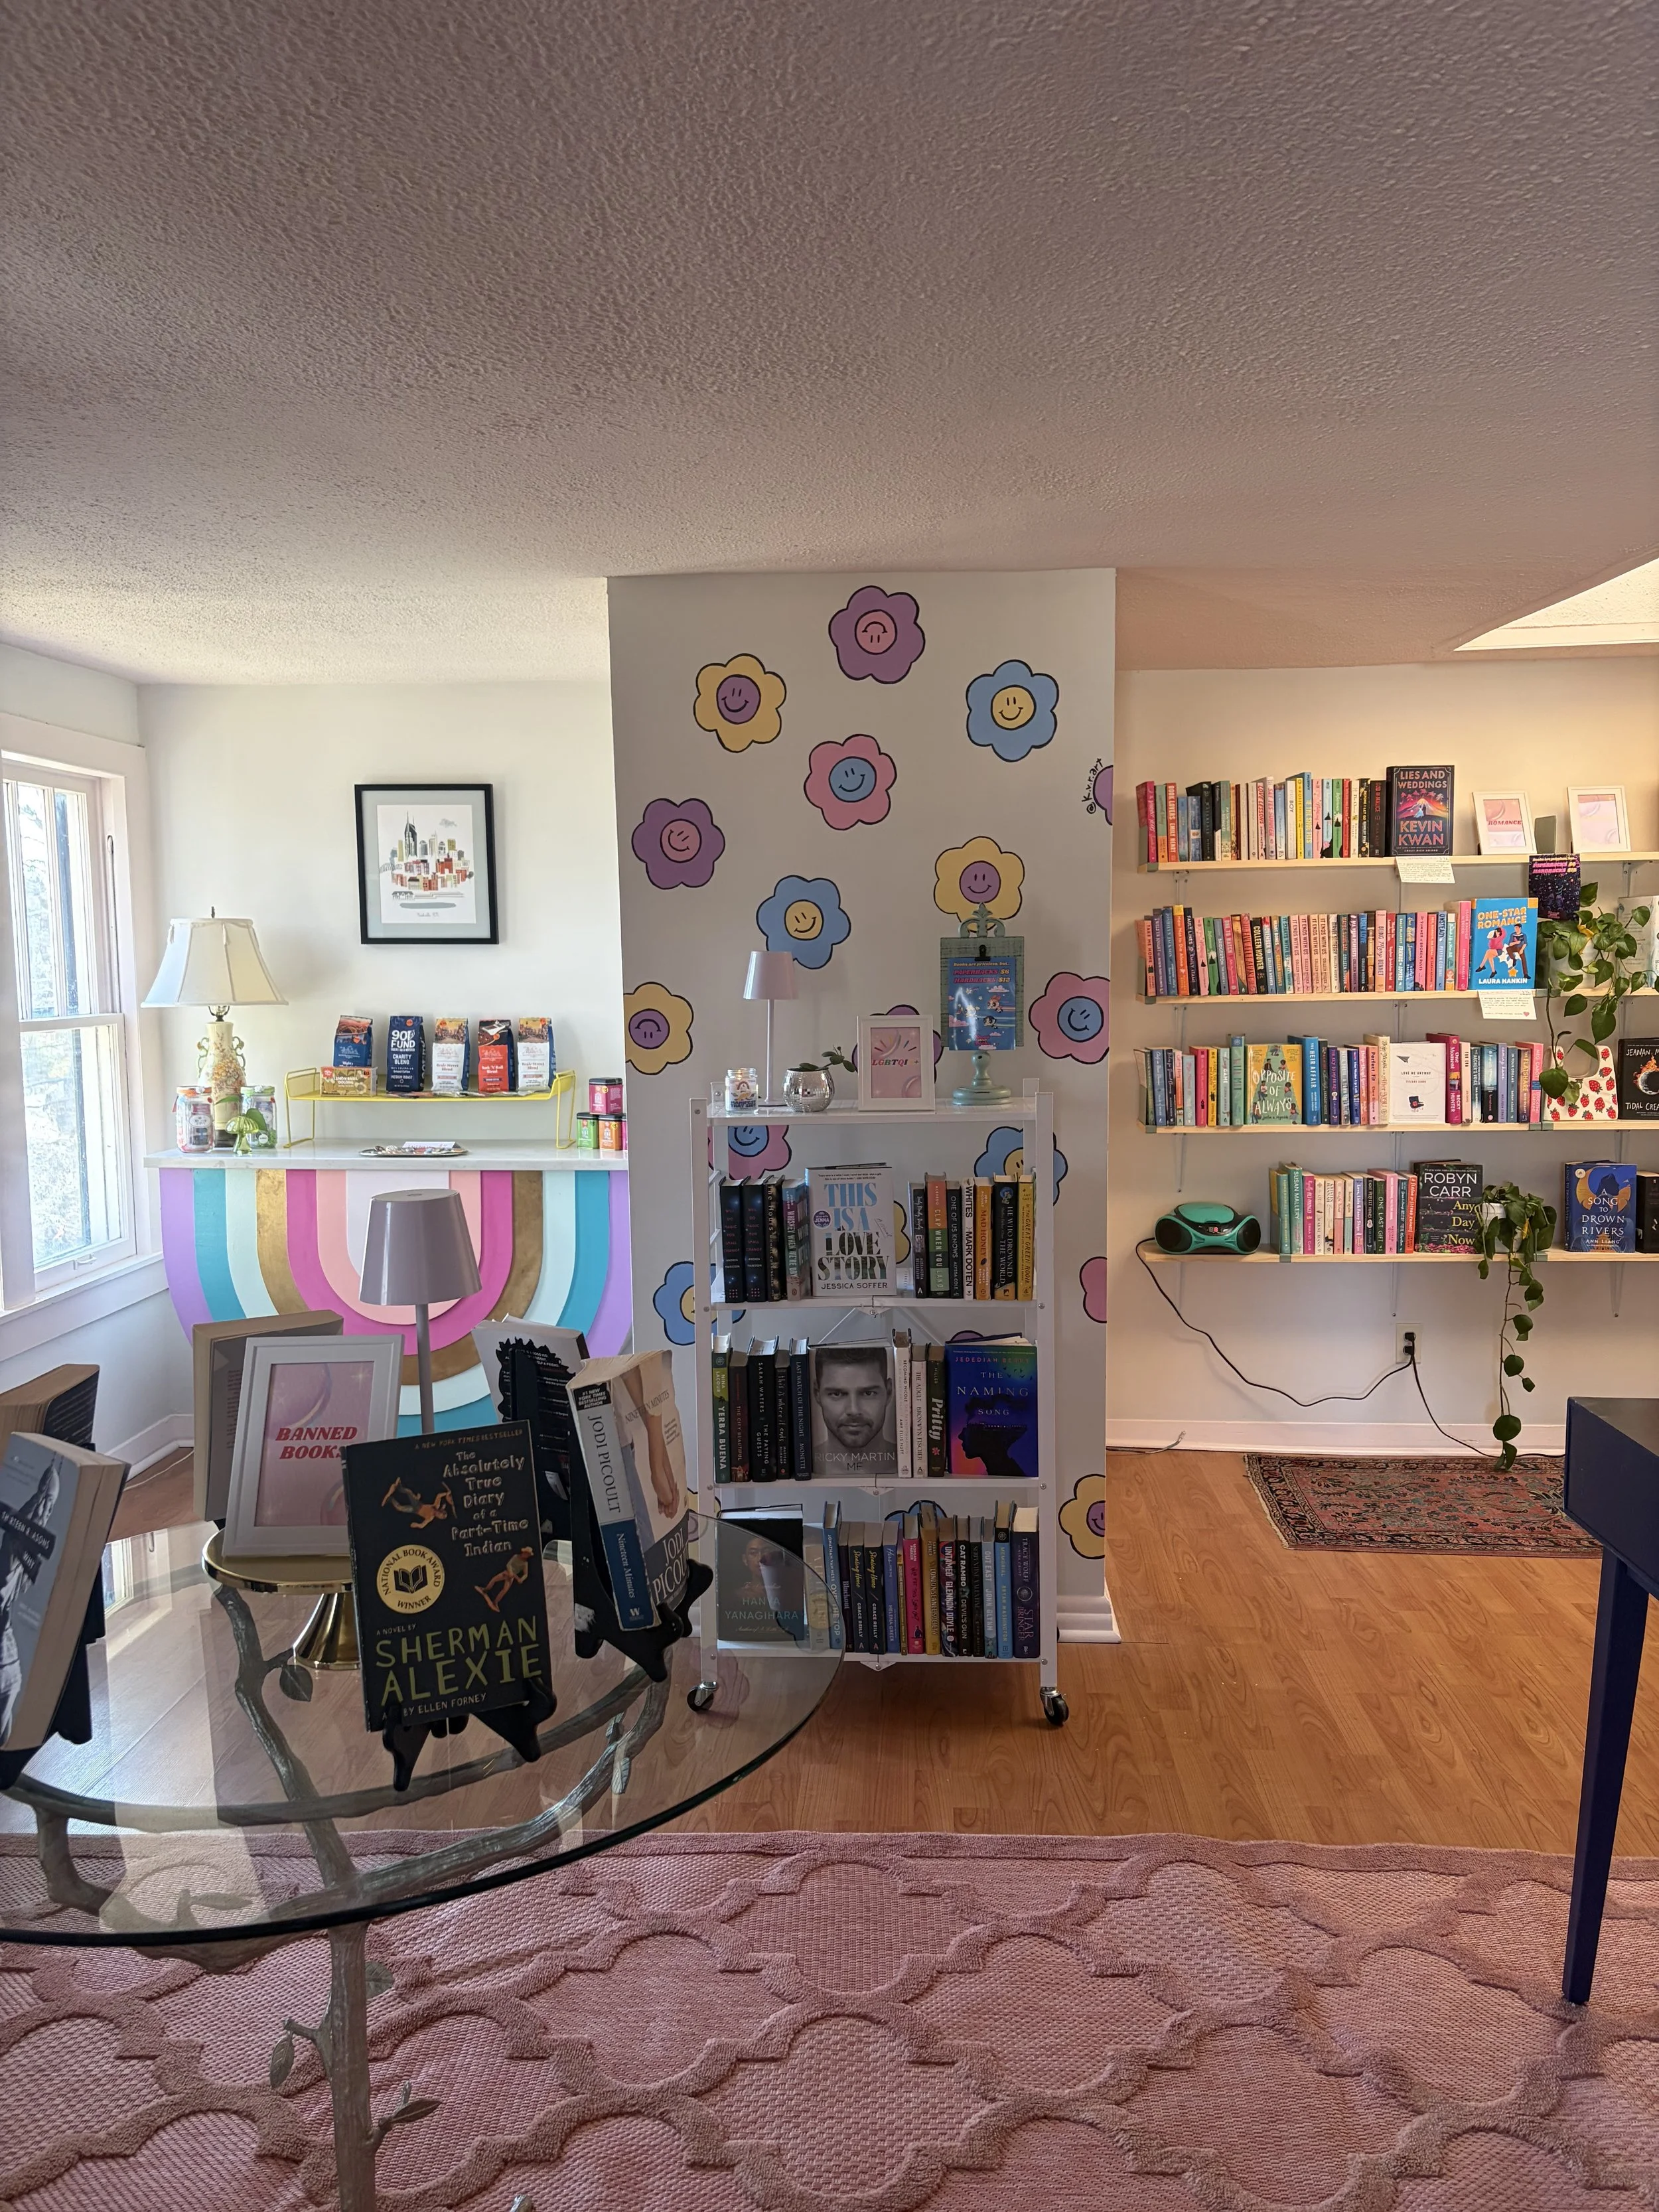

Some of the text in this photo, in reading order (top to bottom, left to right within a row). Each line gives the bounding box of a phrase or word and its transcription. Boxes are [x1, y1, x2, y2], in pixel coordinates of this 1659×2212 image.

[1422, 771, 1445, 779] AND
[1398, 780, 1447, 789] WEDDINGS
[1400, 820, 1443, 833] KEVIN
[1398, 834, 1444, 846] KWAN
[1477, 907, 1526, 920] ONE-STAR
[1477, 916, 1526, 929] ROMANCE
[1256, 950, 1264, 970] HOOVER
[1252, 1068, 1296, 1084] OPPOSITE
[1269, 1086, 1281, 1096] OF
[1255, 1097, 1292, 1115] ALWAYS
[1424, 1173, 1477, 1185] ROBYN
[824, 1183, 877, 1207] THIS
[1429, 1186, 1471, 1197] CARR
[1453, 1202, 1475, 1213] Any
[1587, 1197, 1619, 1207] SONG
[952, 1213, 957, 1221] OF
[1007, 1207, 1013, 1216] HE
[834, 1208, 854, 1231] IS
[857, 1208, 871, 1231] A
[1452, 1216, 1475, 1228] Day
[1581, 1215, 1625, 1224] DROWN
[952, 1224, 958, 1232] US
[1582, 1227, 1624, 1238] RIVERS
[826, 1231, 881, 1256] LOVE
[1448, 1234, 1475, 1246] Now
[818, 1256, 889, 1281] STORY
[957, 1386, 1029, 1396] NAMING
[579, 1396, 607, 1405] BESTSELLING
[928, 1398, 944, 1440] Pritty
[275, 1427, 357, 1441] BANNED
[456, 1451, 476, 1461] The
[816, 1452, 895, 1462] RICKY MARTIN
[443, 1455, 525, 1478] Absolutely
[587, 1415, 621, 1513] JODI PICOULT
[465, 1476, 502, 1491] True
[463, 1492, 504, 1509] Diary
[473, 1509, 486, 1520] of
[1, 1511, 50, 1549] THRTEEN RASONS
[451, 1519, 529, 1540] Part-Time
[464, 1540, 512, 1556] Indian
[662, 1528, 685, 1566] JODI
[23, 1550, 35, 1570] WHY
[616, 1533, 635, 1598] Nineteen Minutes
[380, 1548, 440, 1595] NATIONAL BOOK AWARD
[397, 1595, 431, 1609] WINNER
[725, 1611, 798, 1620] YANAGIHARA
[383, 1626, 406, 1635] NOVEL
[1023, 1609, 1034, 1639] STAR
[376, 1615, 537, 1668] SHERMAN
[381, 1643, 542, 1706] ALEXIE
[403, 1692, 486, 1716] BY ELLEN FORNEY
